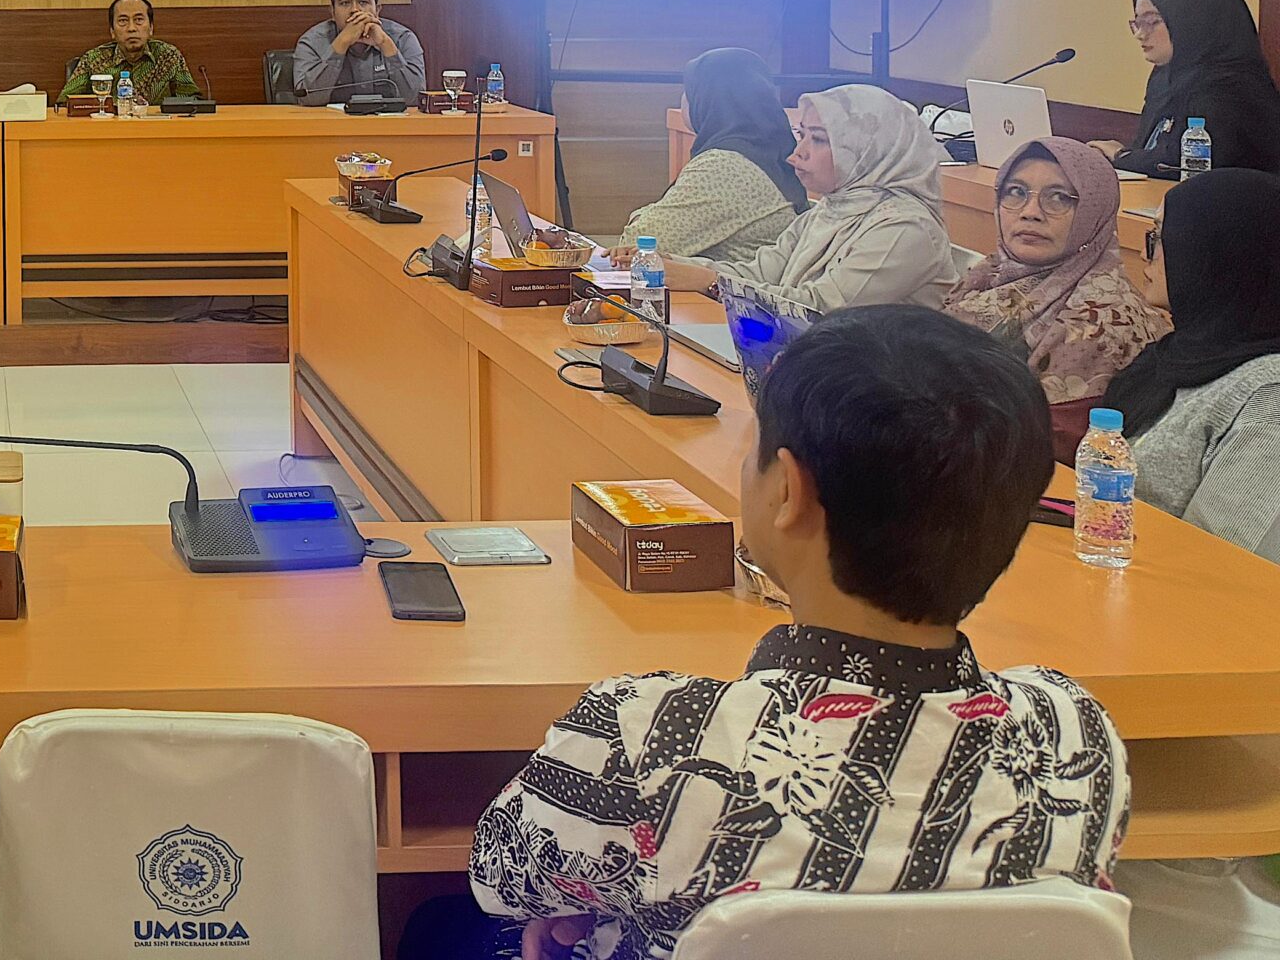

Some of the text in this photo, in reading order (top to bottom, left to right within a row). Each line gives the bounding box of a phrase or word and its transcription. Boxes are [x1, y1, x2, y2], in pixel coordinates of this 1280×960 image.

[267, 490, 311, 500] AUDERPRO
[150, 838, 231, 883] UNIVERSITAS MUHAMMADIYAH
[161, 891, 220, 909] SIDOARJO
[134, 920, 250, 941] UMSIDA
[153, 940, 169, 948] SINI
[170, 940, 219, 948] PENCERAHAN
